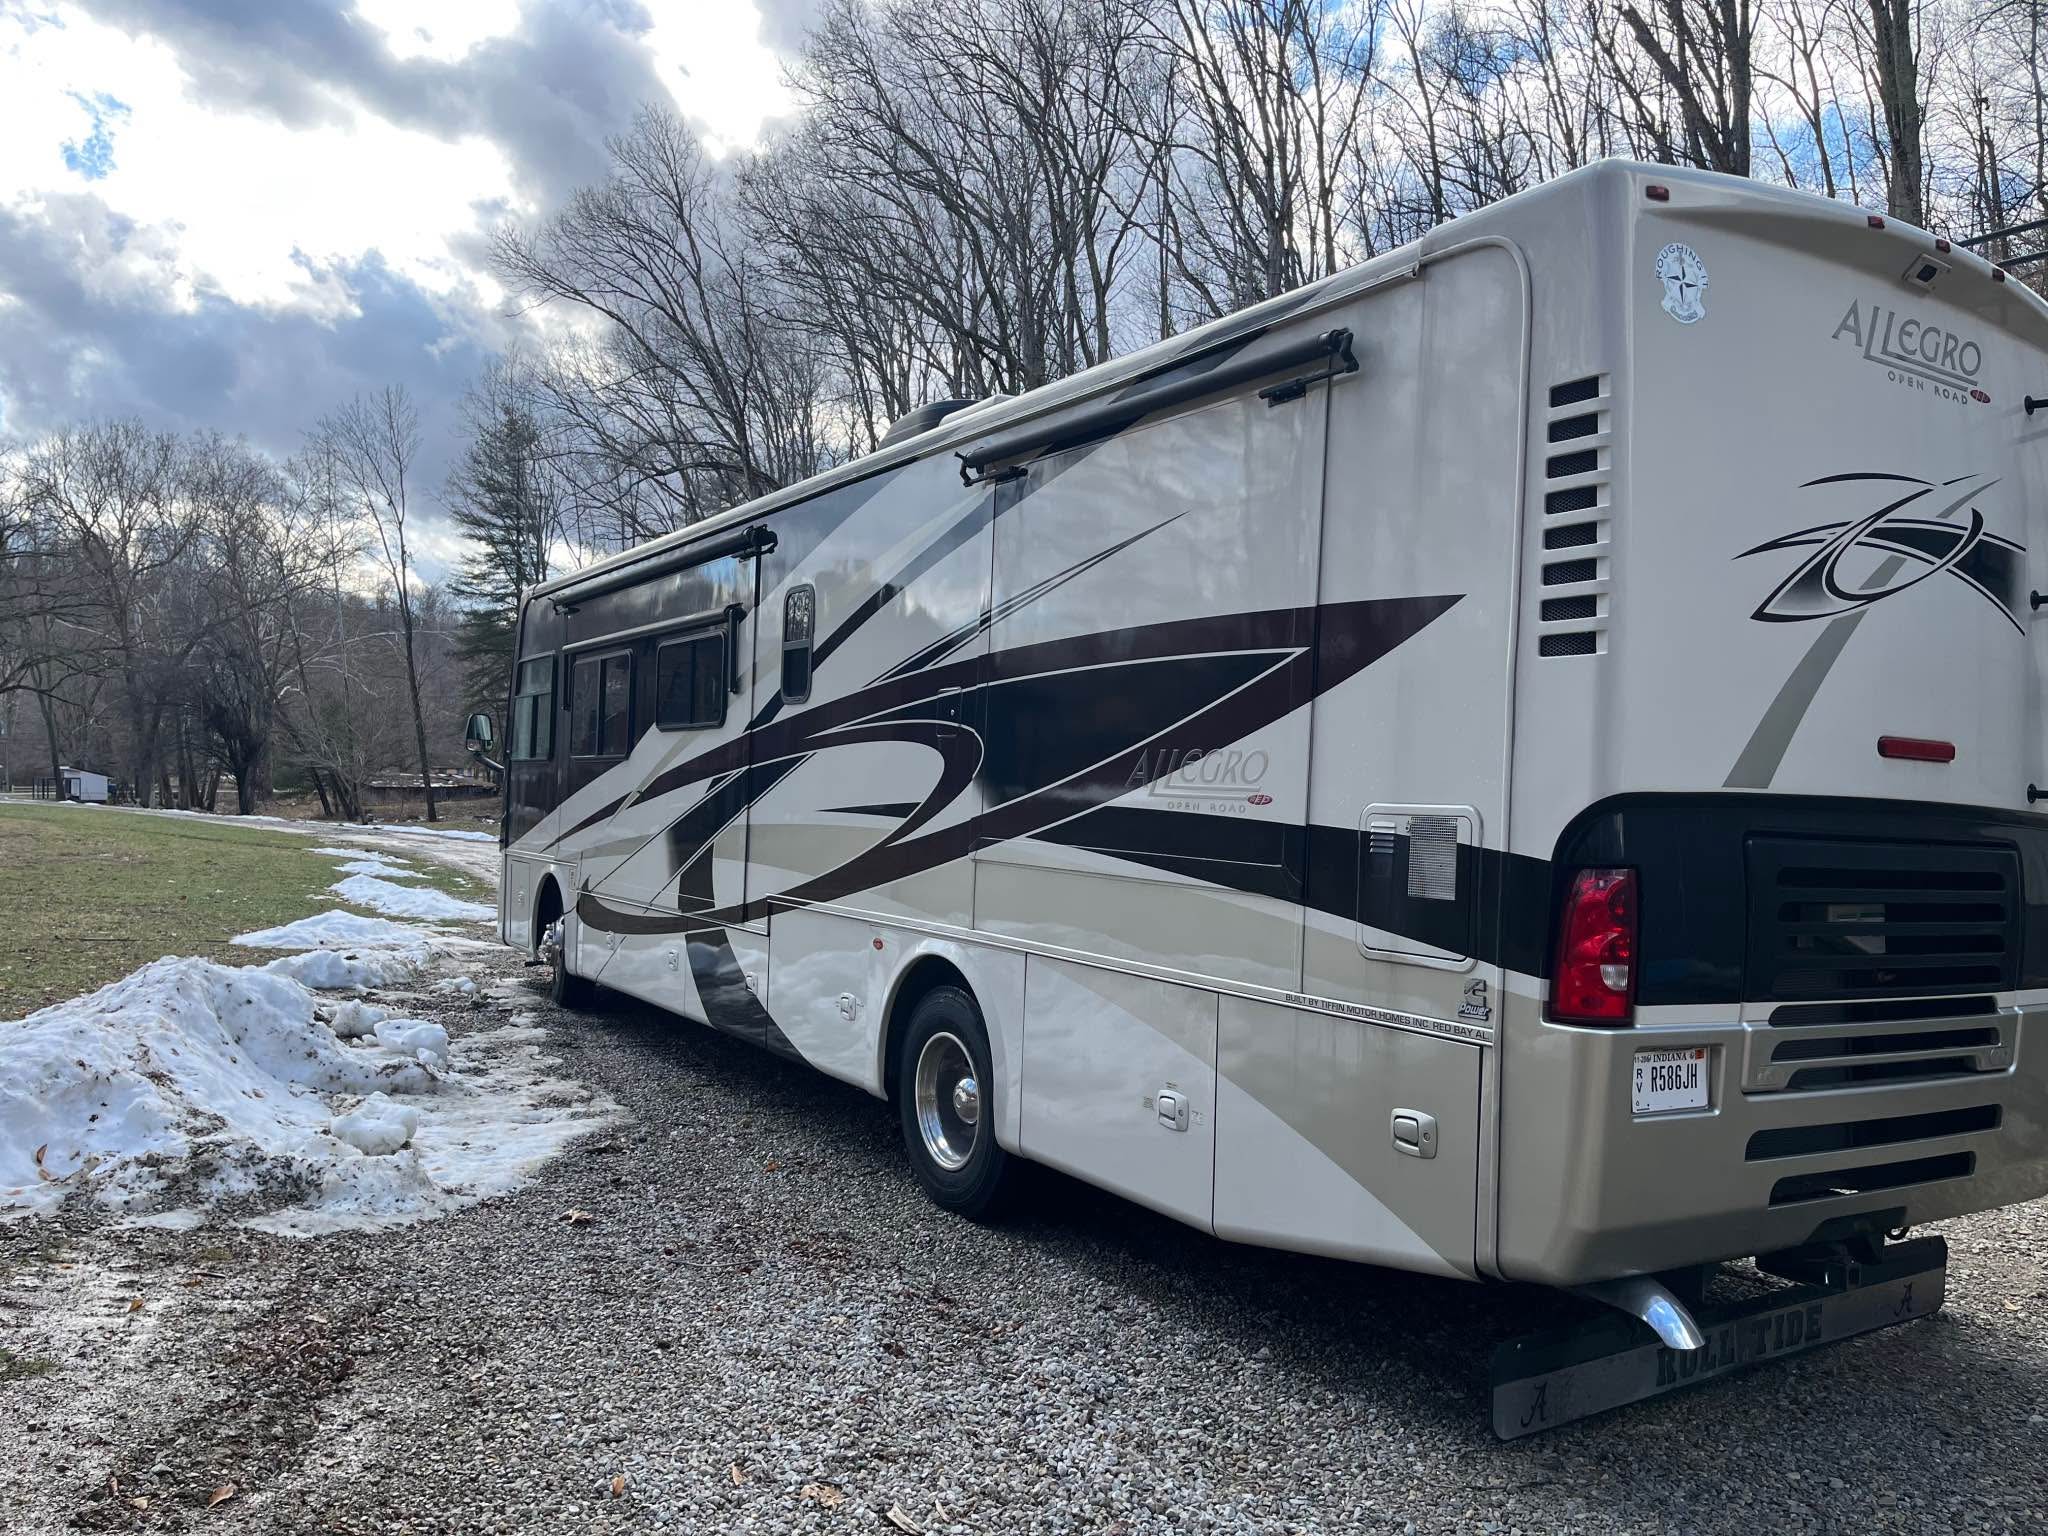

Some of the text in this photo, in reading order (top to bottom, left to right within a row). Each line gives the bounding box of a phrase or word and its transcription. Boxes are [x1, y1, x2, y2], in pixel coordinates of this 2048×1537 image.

[1655, 244, 1703, 279] ROUGHING
[1831, 298, 1982, 390] ALLEGRO
[1887, 370, 1925, 391] OPEN
[1934, 385, 1968, 405] ROAD
[1125, 747, 1270, 799] ALLEGRO
[1167, 801, 1247, 814] OPEN ROAD
[1285, 993, 1307, 1005] BUILT
[1308, 997, 1319, 1007] BY
[1320, 1000, 1345, 1012] TIFFIN
[1346, 1005, 1377, 1018] MOTOR
[1378, 1011, 1411, 1025] HOMES
[1432, 1021, 1452, 1033] RED
[1453, 1025, 1475, 1037] BAY
[1653, 1052, 1687, 1063] INDIANA
[1651, 1063, 1697, 1093] R586JH
[1751, 1303, 1823, 1355] TIDE
